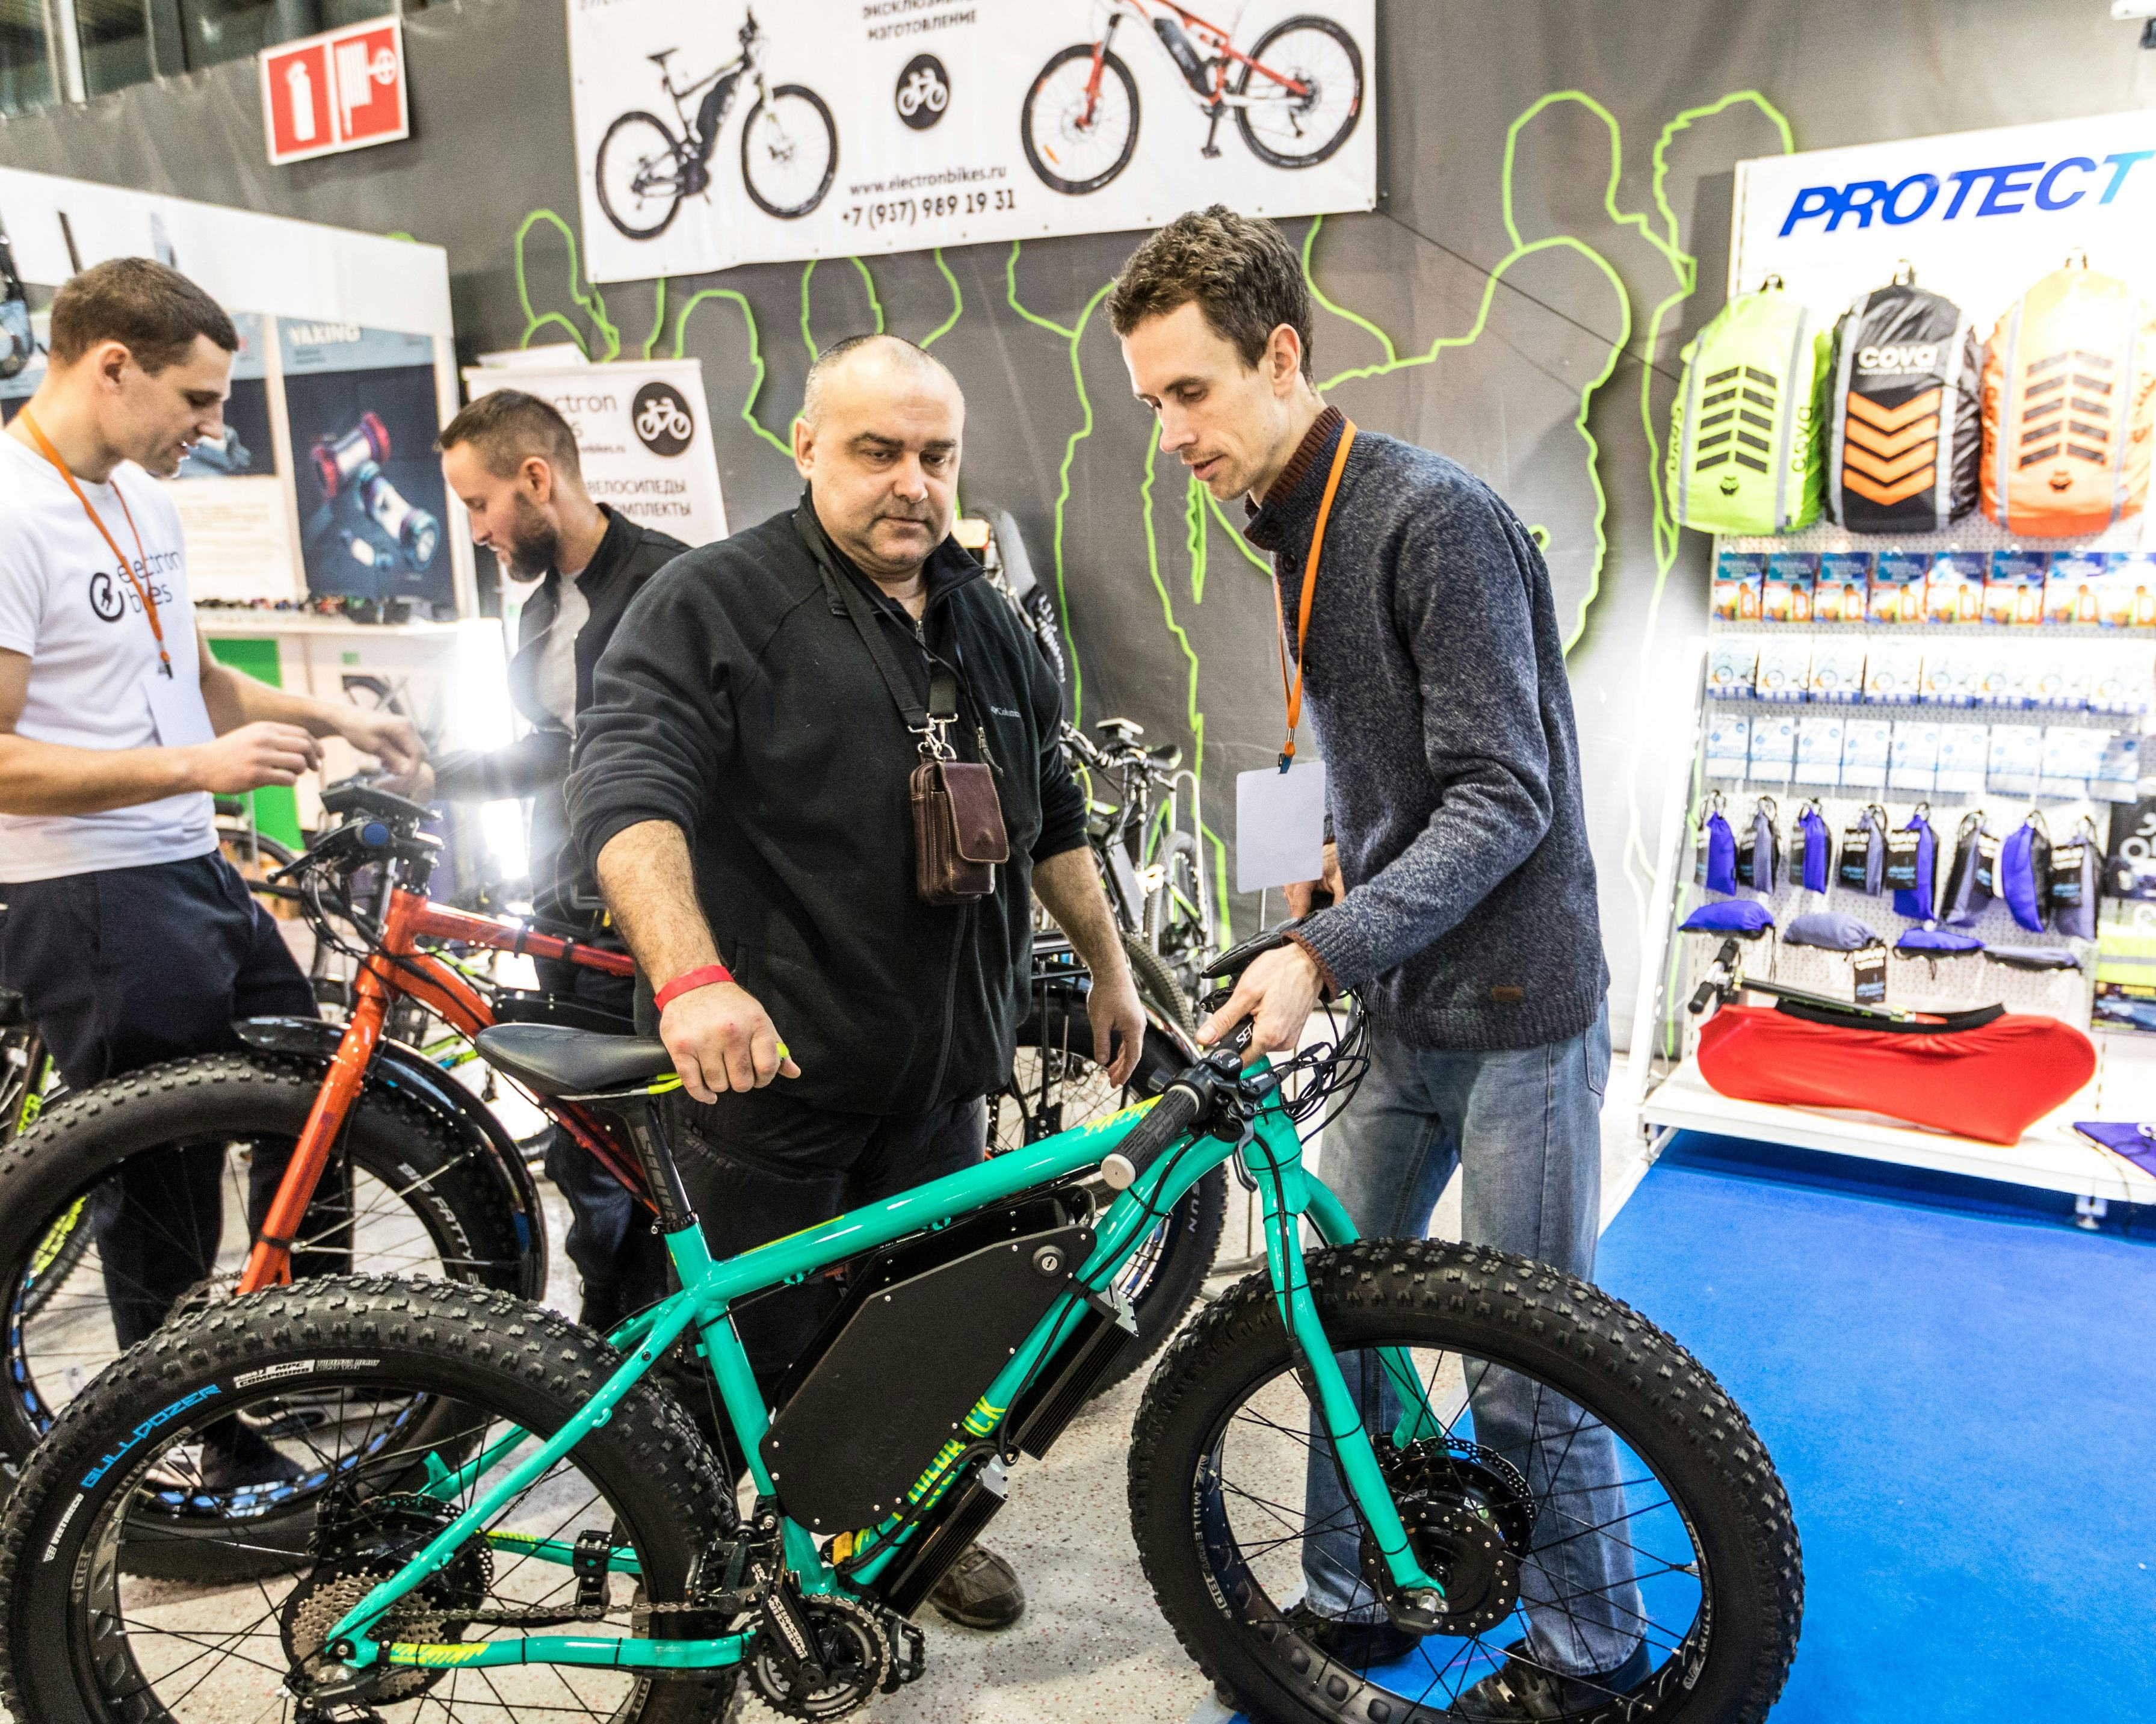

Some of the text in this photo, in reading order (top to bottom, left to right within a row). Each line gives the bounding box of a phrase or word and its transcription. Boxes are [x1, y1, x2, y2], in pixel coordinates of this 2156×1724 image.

[850, 167, 1006, 195] www.electronbikes.ru
[1778, 149, 2156, 238] PROTECT
[843, 189, 1015, 230] +7 (937) 989 19 31
[1858, 345, 1938, 368] cova
[1791, 406, 1813, 473] cova
[613, 502, 693, 517] ОМПЛЕКТЫ
[239, 1367, 310, 1386] COMPOUND
[79, 1383, 222, 1488] BULLDOZER
